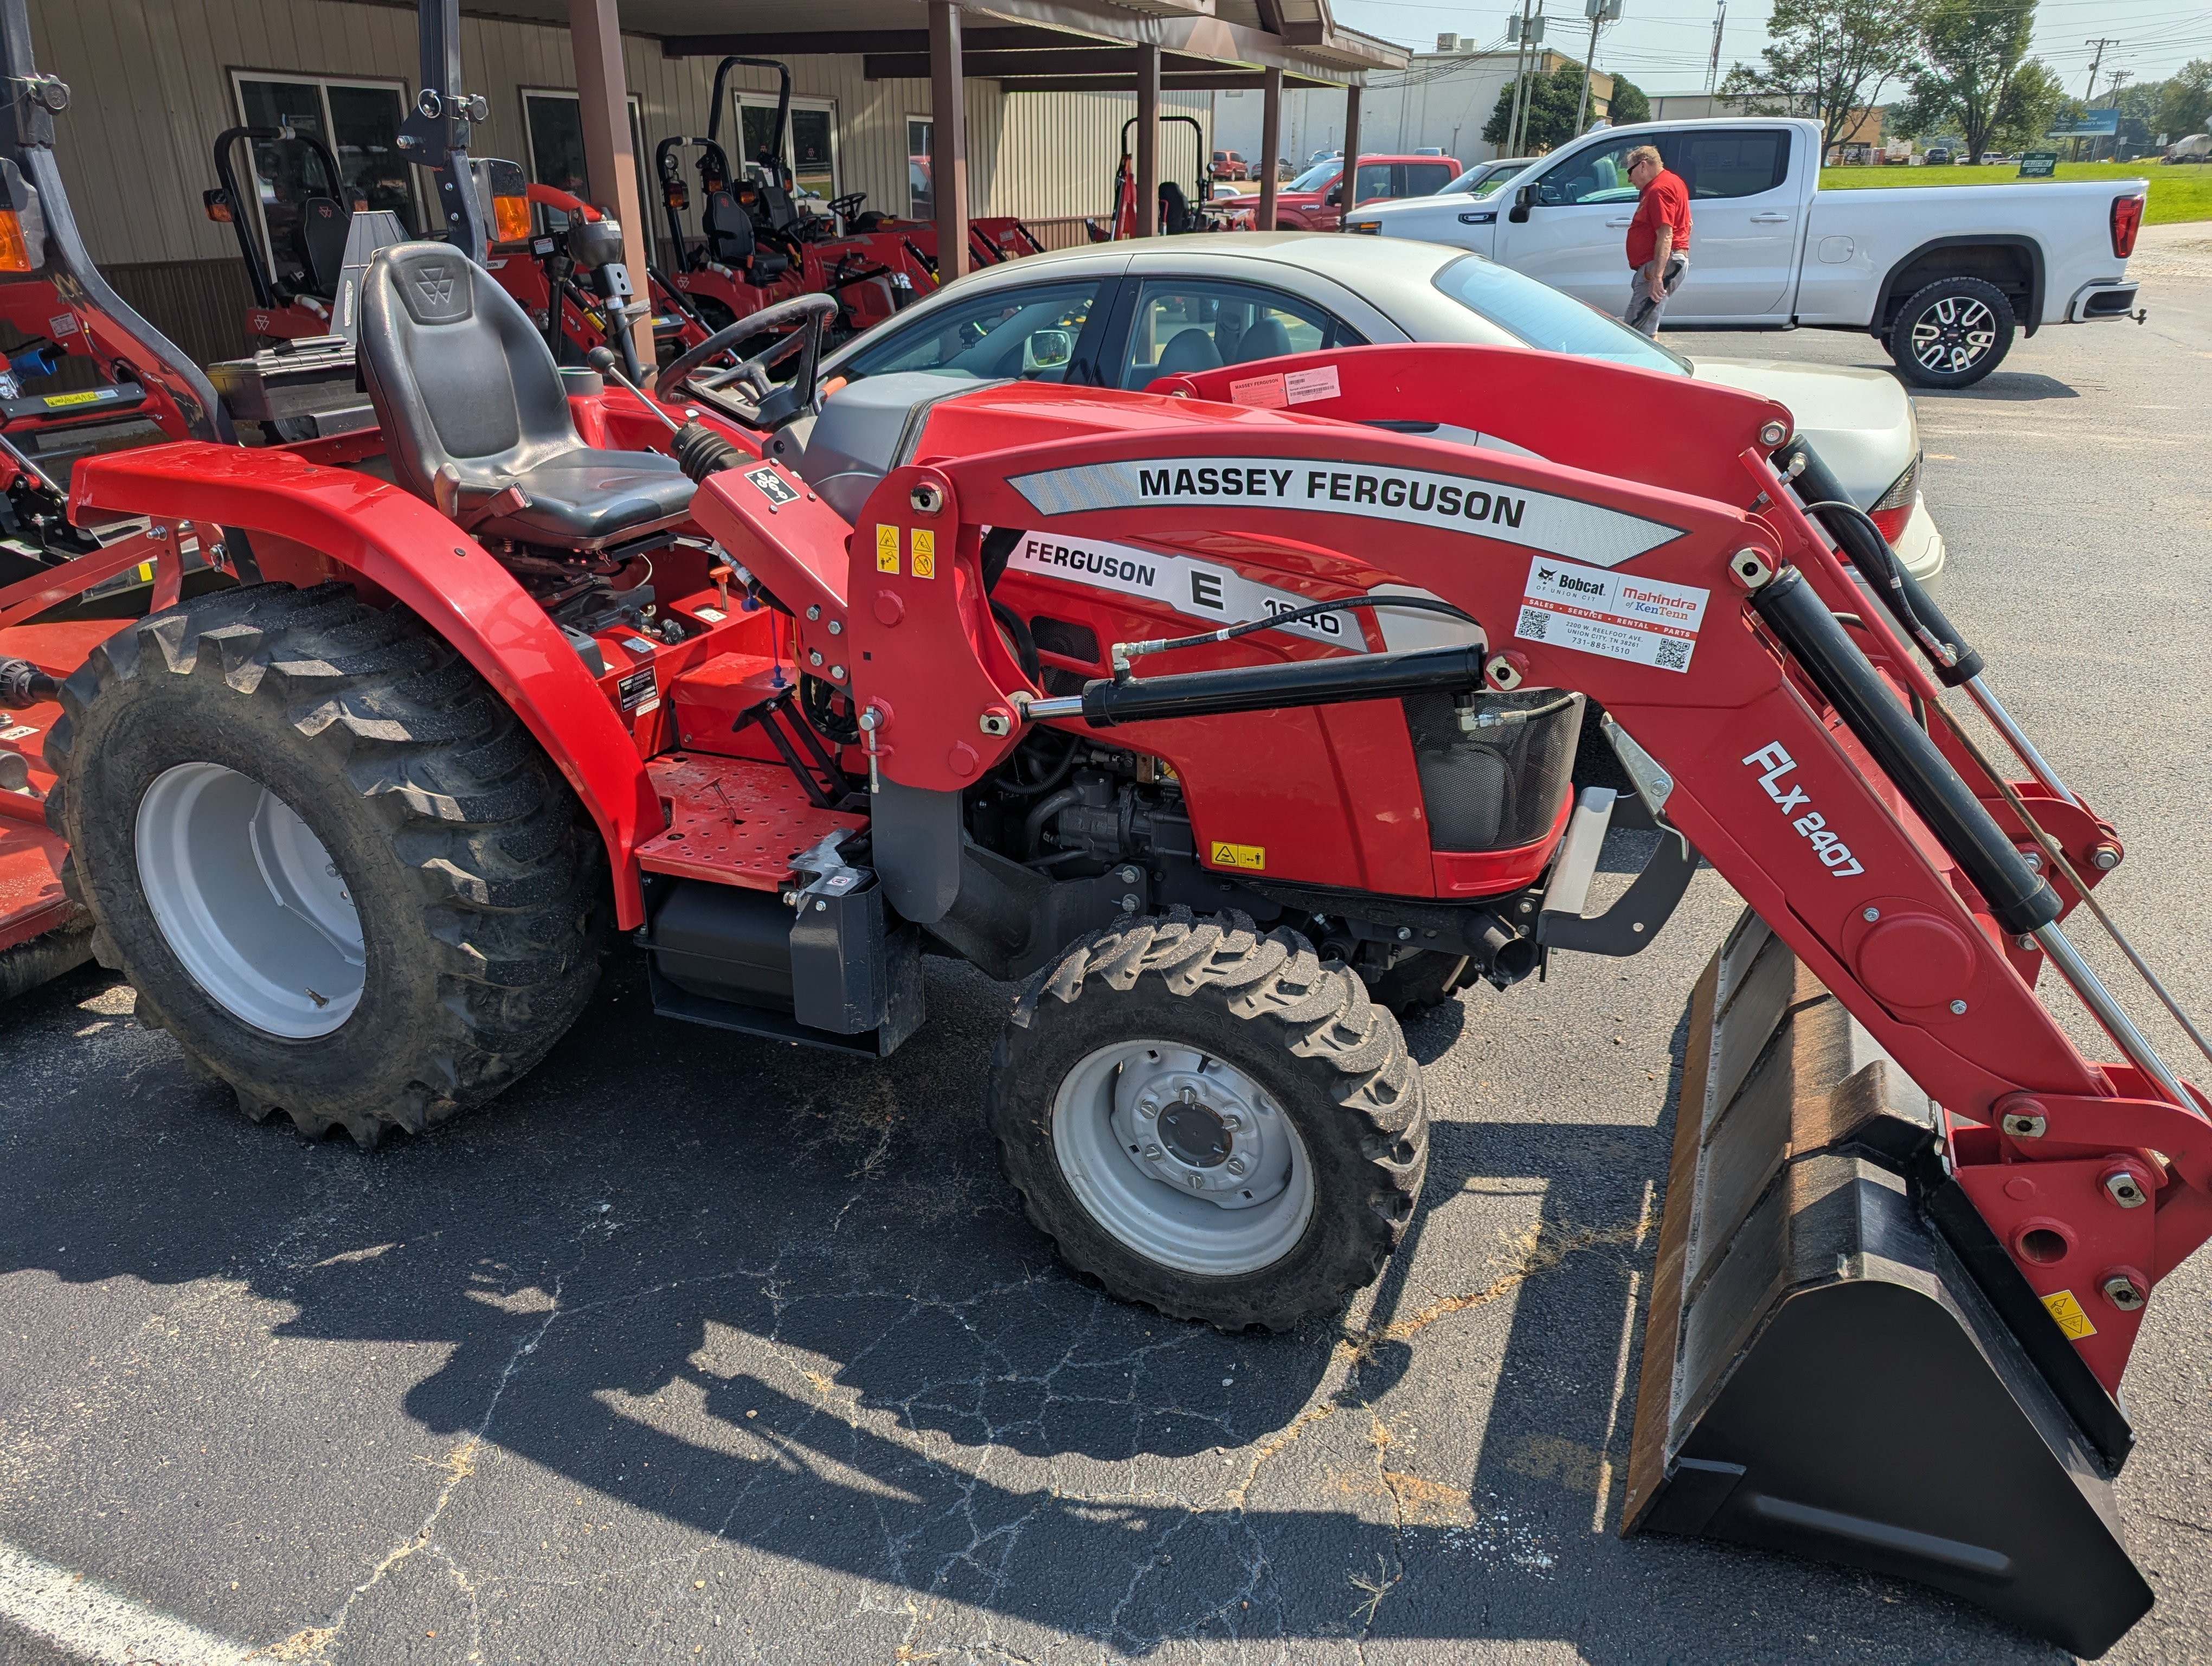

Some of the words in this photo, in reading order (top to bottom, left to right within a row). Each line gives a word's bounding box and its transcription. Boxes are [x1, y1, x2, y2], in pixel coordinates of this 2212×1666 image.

[1254, 378, 1279, 387] FERGUSON
[1139, 468, 1294, 497] MASSEY
[1307, 471, 1526, 529] FERGUSON
[1025, 540, 1156, 587] FERGUSON
[1191, 570, 1224, 611] E
[1559, 574, 1605, 596] Bobcat
[1551, 588, 1578, 598] UNION
[1623, 587, 1697, 611] Mahindra
[1529, 599, 1554, 609] SALES
[1567, 607, 1603, 620] SERVICE
[1617, 618, 1649, 629] RENTAL
[1664, 627, 1690, 637] PARTS
[1635, 602, 1688, 620] KenTenn
[1567, 628, 1590, 637] UNION
[1591, 633, 1607, 642] CITY,
[1620, 640, 1639, 648] 38261
[1592, 627, 1628, 638] REELFOOT
[1572, 637, 1630, 655] 731-885-1510
[1792, 812, 1866, 877] 2407
[1169, 1001, 1333, 1110] GALAXY
